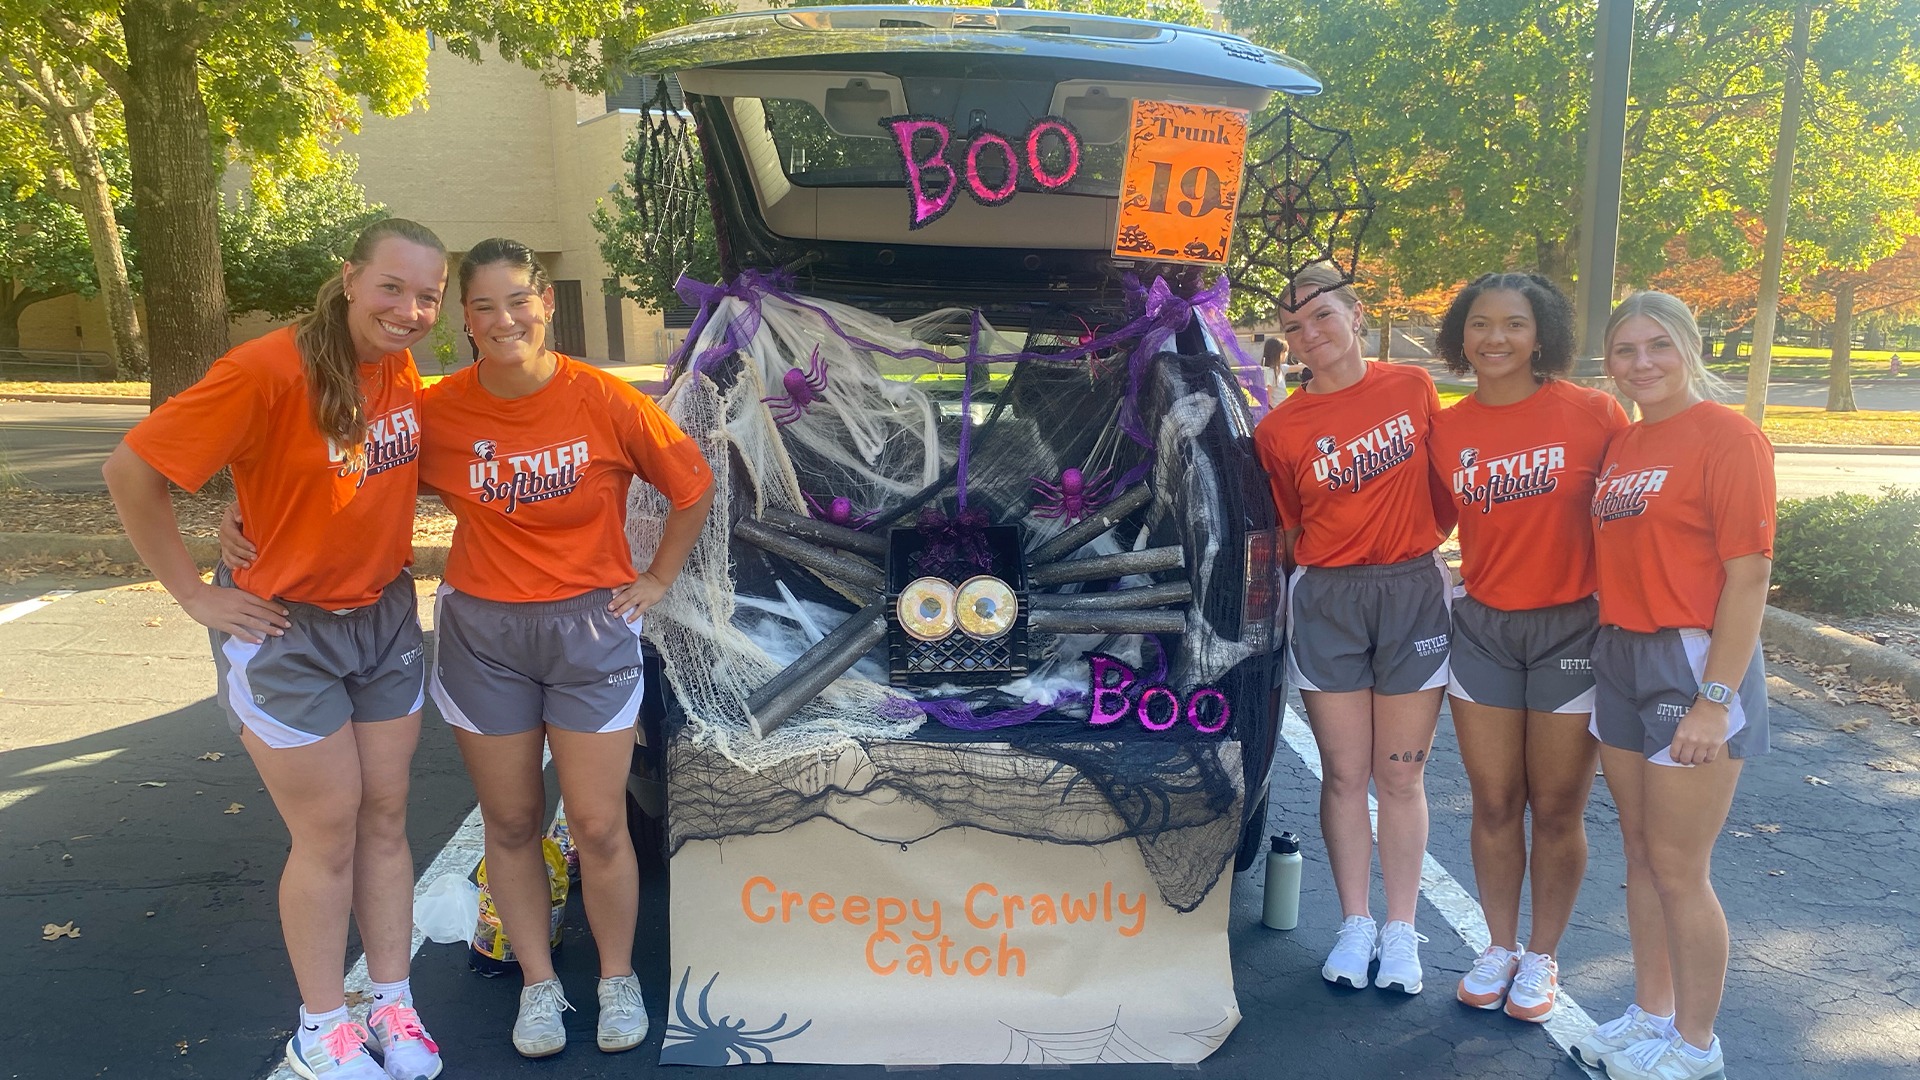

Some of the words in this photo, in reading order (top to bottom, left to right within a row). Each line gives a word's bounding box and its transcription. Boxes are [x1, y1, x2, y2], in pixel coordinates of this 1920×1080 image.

[1154, 116, 1232, 146] Trunk
[1147, 159, 1224, 218] 19
[469, 460, 500, 489] UT
[508, 440, 589, 478] TYLER
[1312, 449, 1343, 482] UT
[1345, 414, 1415, 460] TYLER
[1328, 433, 1415, 494] Softball
[1453, 465, 1479, 495] UT
[1486, 446, 1565, 482] TYLER
[479, 463, 585, 514] Softball
[1462, 463, 1558, 515] Softball
[741, 875, 943, 942] Creepy
[964, 880, 1147, 937] Crawly
[865, 929, 1027, 978] Catch
